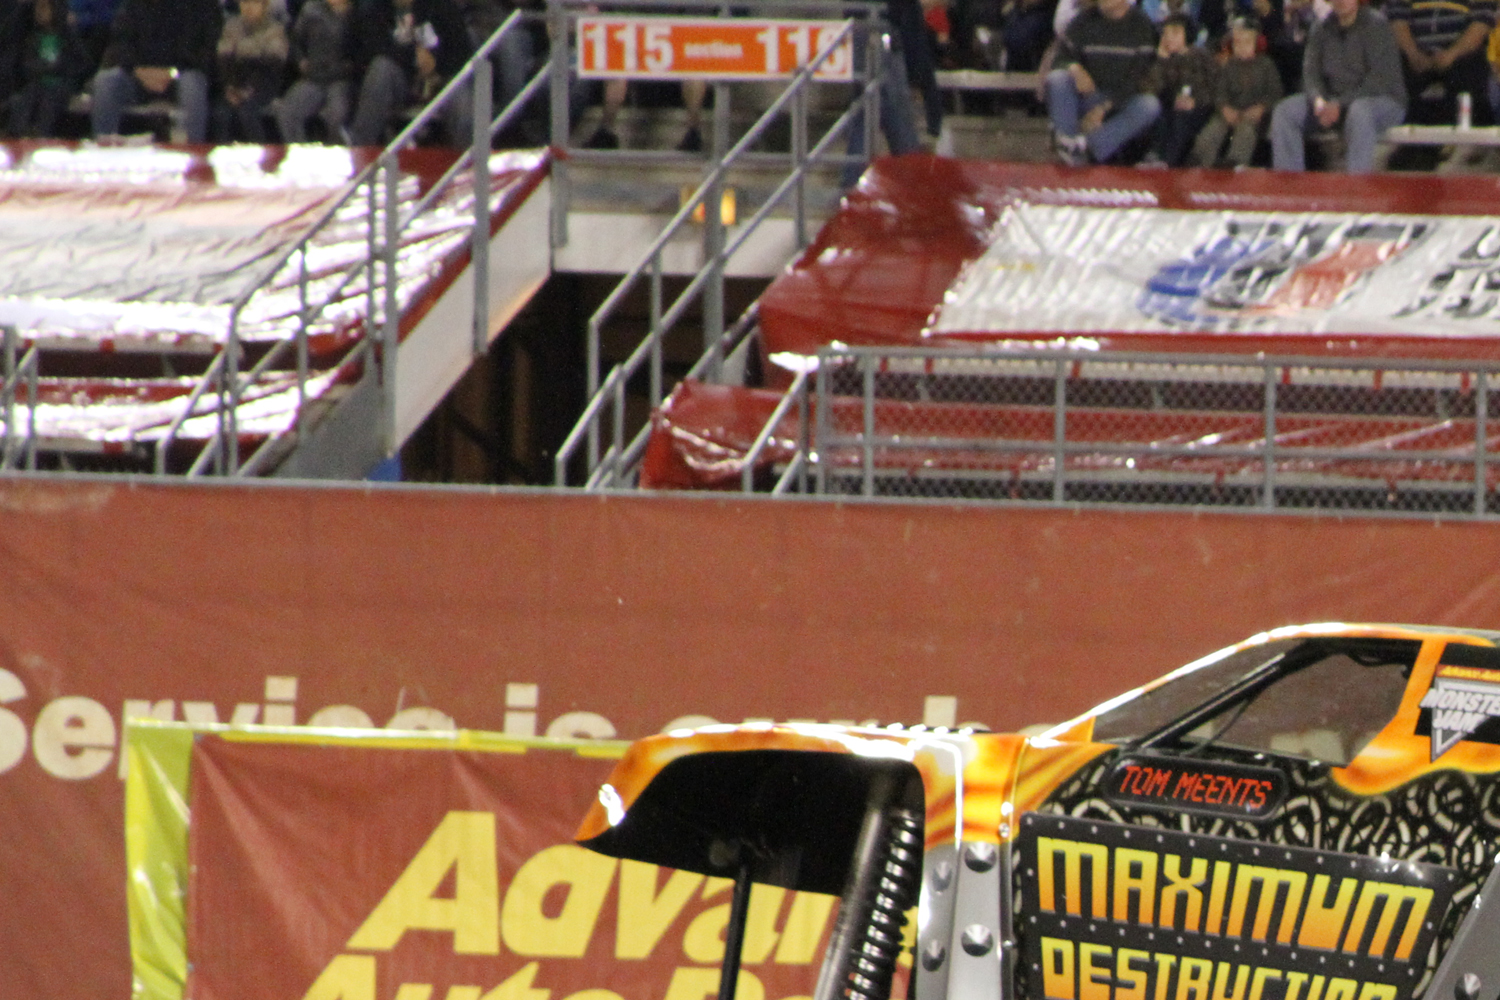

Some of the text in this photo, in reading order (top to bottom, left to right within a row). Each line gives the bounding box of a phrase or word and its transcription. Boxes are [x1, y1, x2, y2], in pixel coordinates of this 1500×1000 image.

[582, 23, 674, 72] 115
[1432, 709, 1487, 734] JAM
[1119, 765, 1273, 809] TOM MEENTS
[1037, 836, 1435, 962] MAXIMUM
